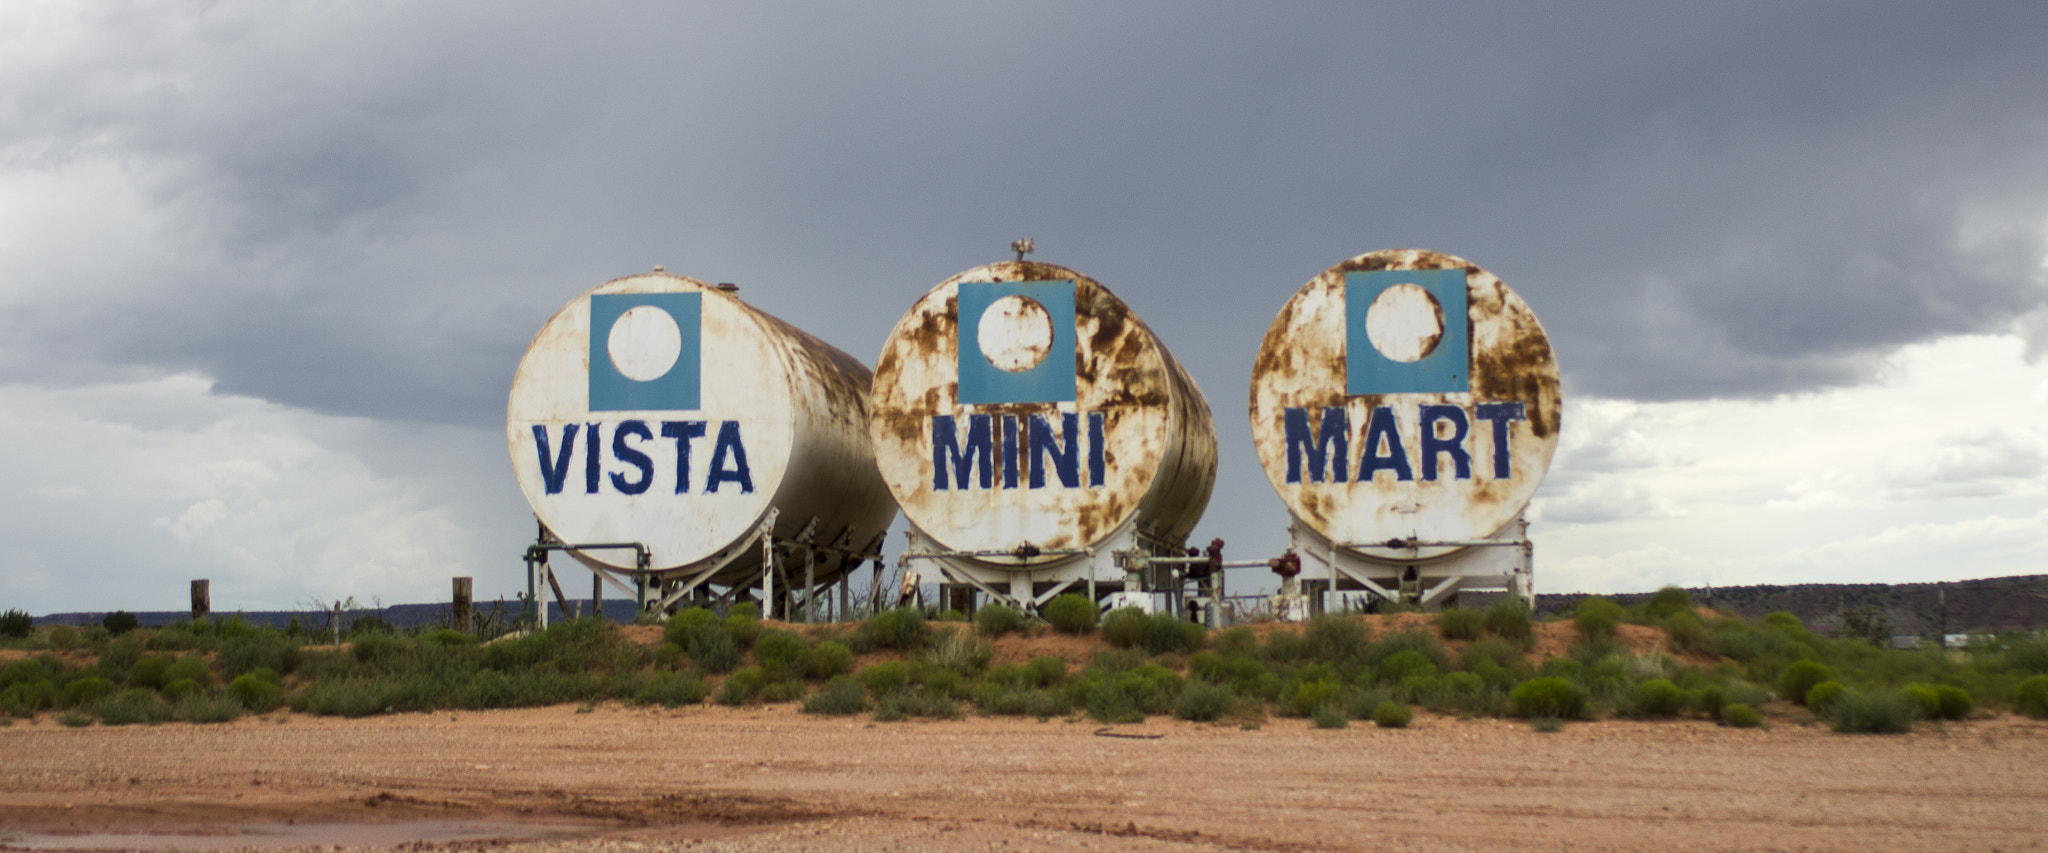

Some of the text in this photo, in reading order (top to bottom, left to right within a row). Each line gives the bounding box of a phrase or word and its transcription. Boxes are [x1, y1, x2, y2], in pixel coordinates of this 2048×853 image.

[532, 420, 755, 495] VISTA
[932, 412, 1106, 490] MINI
[1284, 402, 1526, 483] MART
